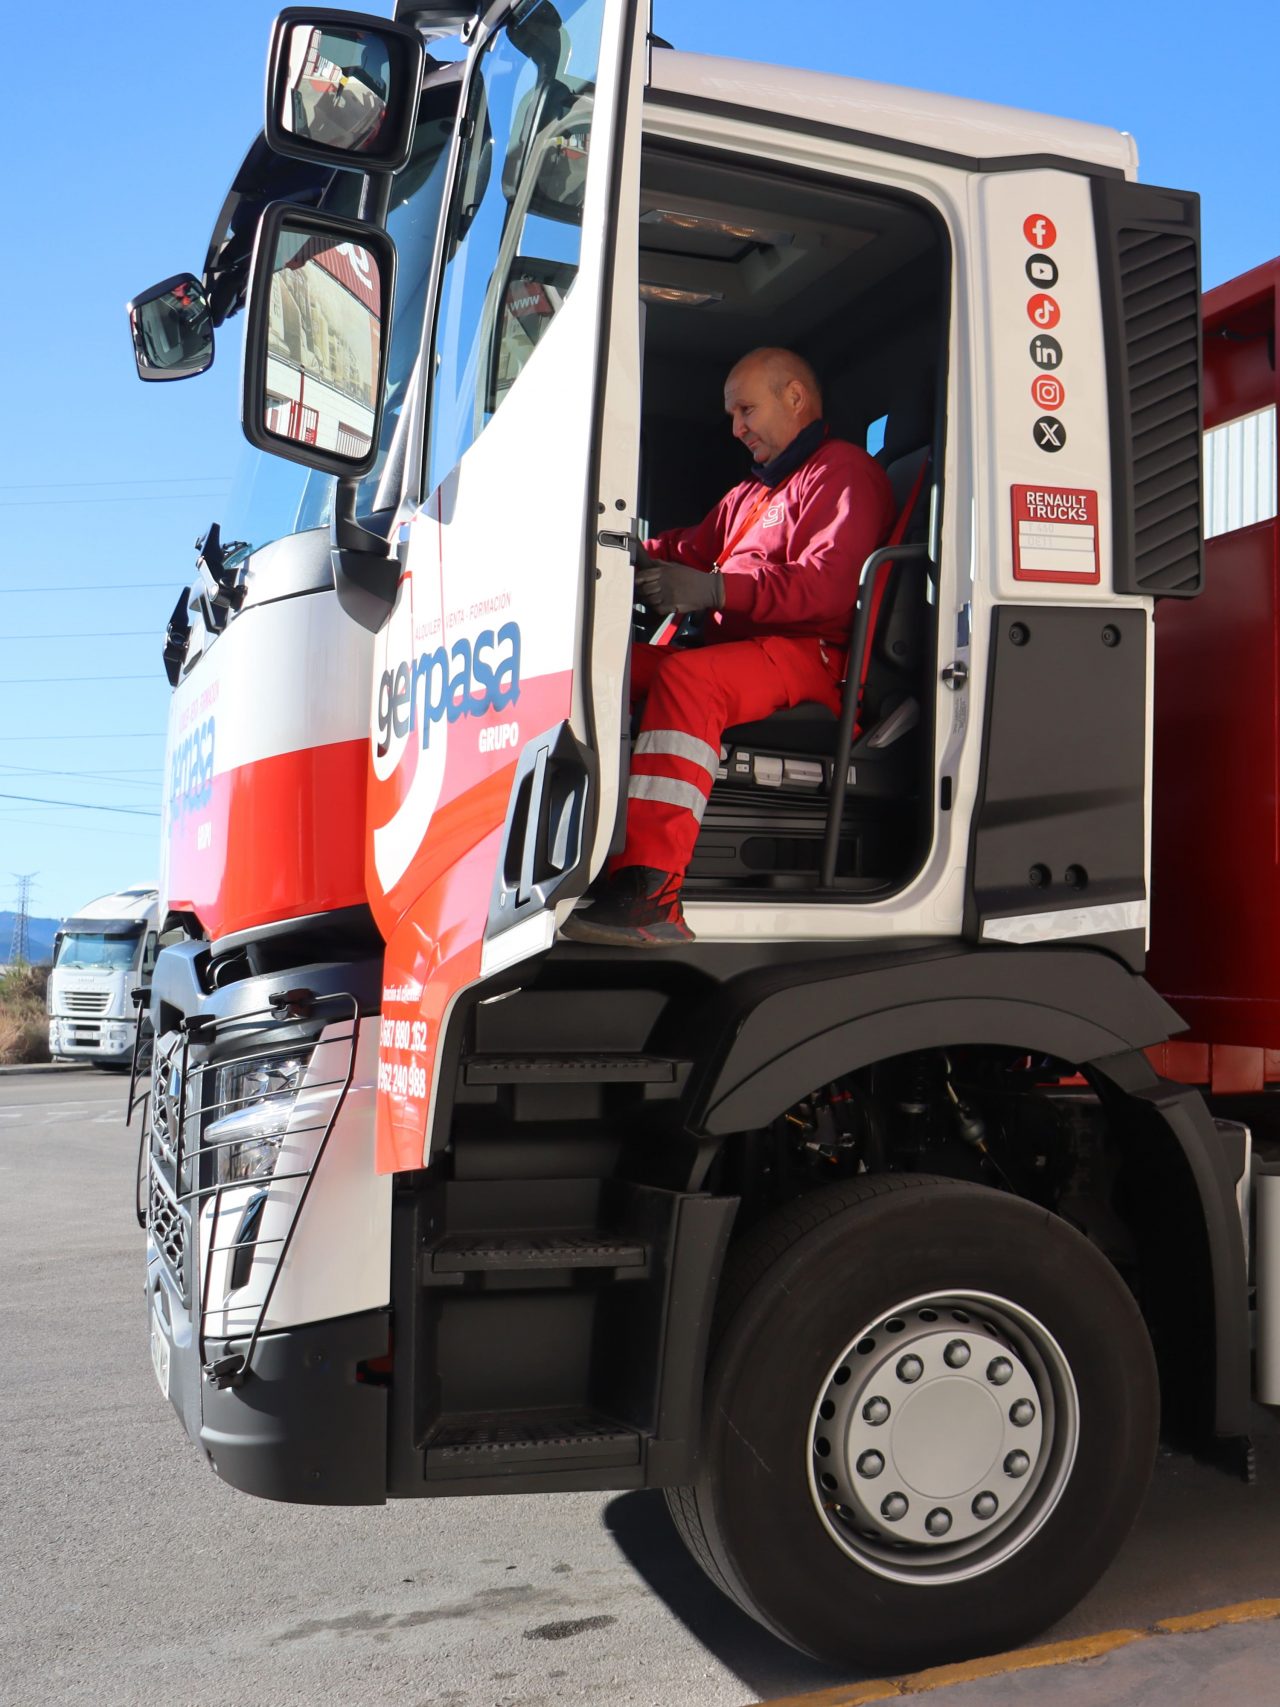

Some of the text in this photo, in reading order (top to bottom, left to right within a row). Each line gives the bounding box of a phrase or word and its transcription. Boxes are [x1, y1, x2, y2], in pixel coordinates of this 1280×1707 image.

[1026, 491, 1087, 508] RENAULT
[1027, 504, 1088, 521] TRUCKS
[445, 608, 464, 629] VENTA
[377, 621, 521, 758] gerpasa
[478, 721, 519, 753] GRUPO
[395, 1019, 410, 1050] 880
[410, 1020, 427, 1052] 162
[392, 1063, 408, 1095] 240
[408, 1066, 426, 1098] 988
